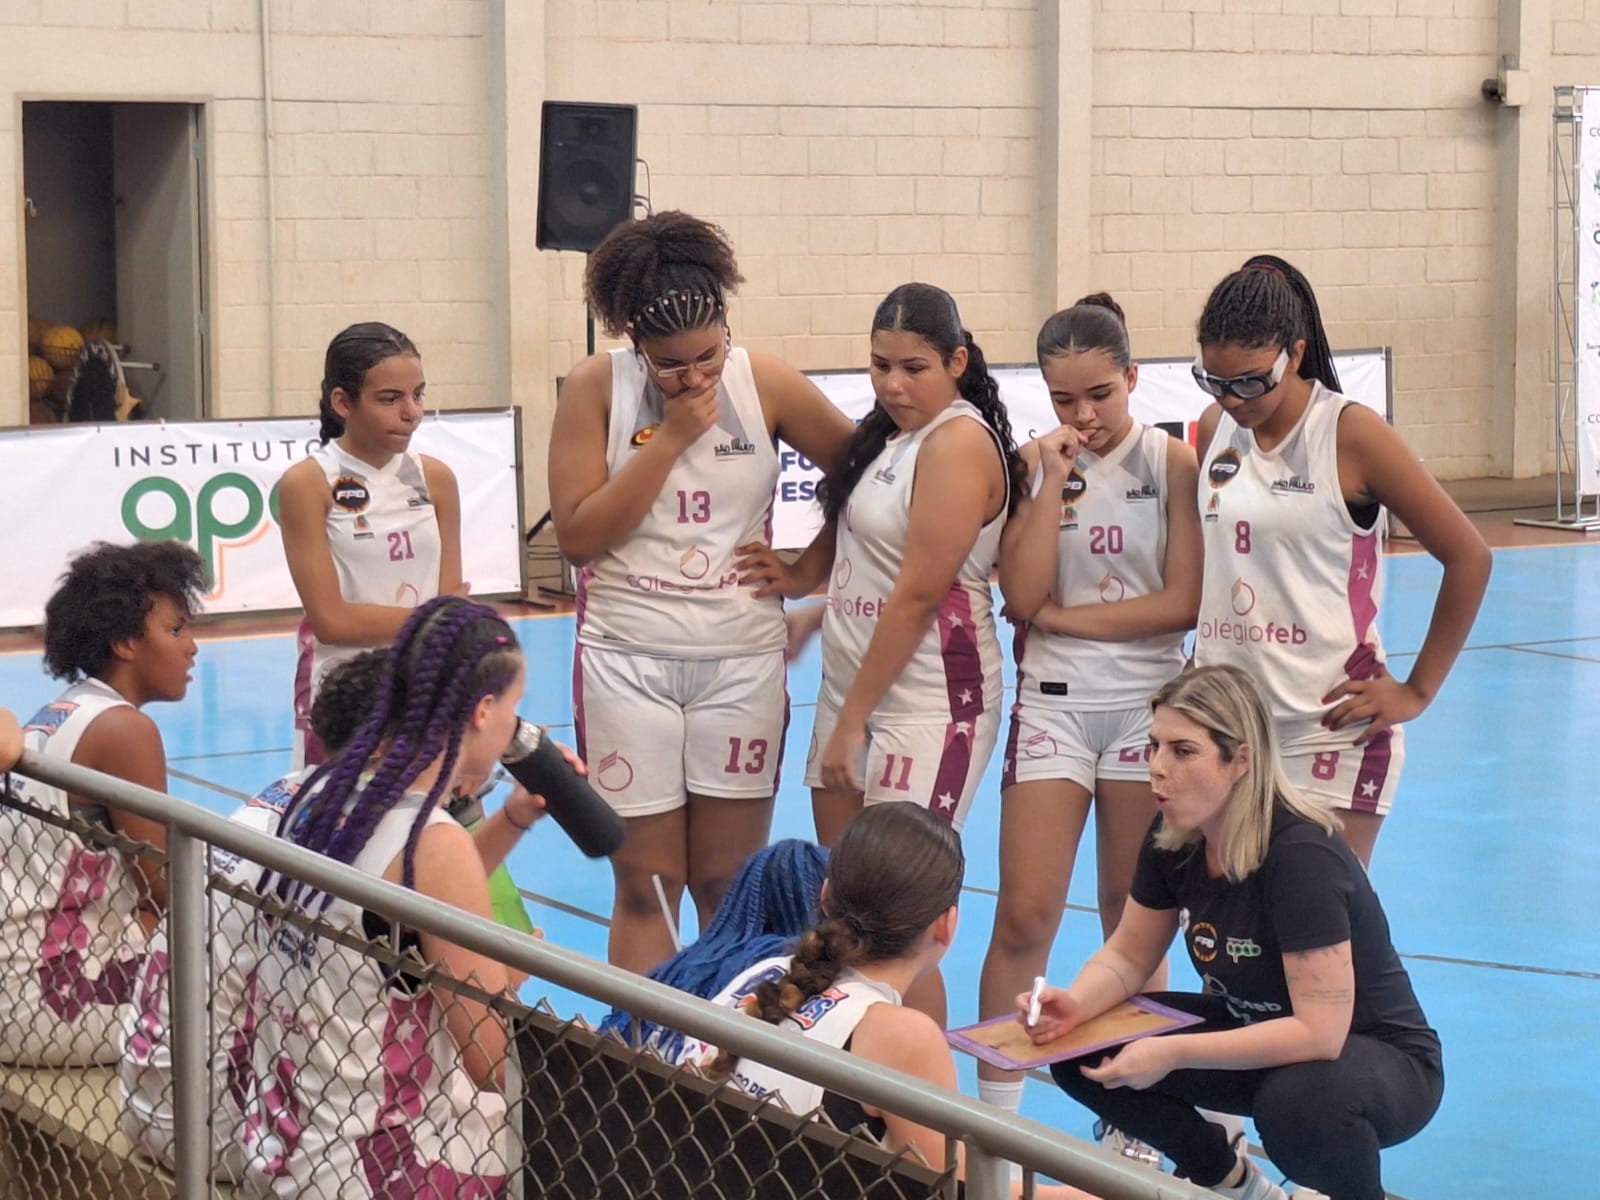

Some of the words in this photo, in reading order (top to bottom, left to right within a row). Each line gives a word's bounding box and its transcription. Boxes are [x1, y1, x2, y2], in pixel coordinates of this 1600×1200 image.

[677, 490, 710, 523] 13
[121, 472, 284, 592] ap
[387, 530, 415, 561] 21
[1089, 525, 1123, 554] 20
[1235, 520, 1251, 554] 8
[724, 736, 768, 774] 13
[1312, 751, 1340, 781] 8
[879, 753, 914, 791] 11
